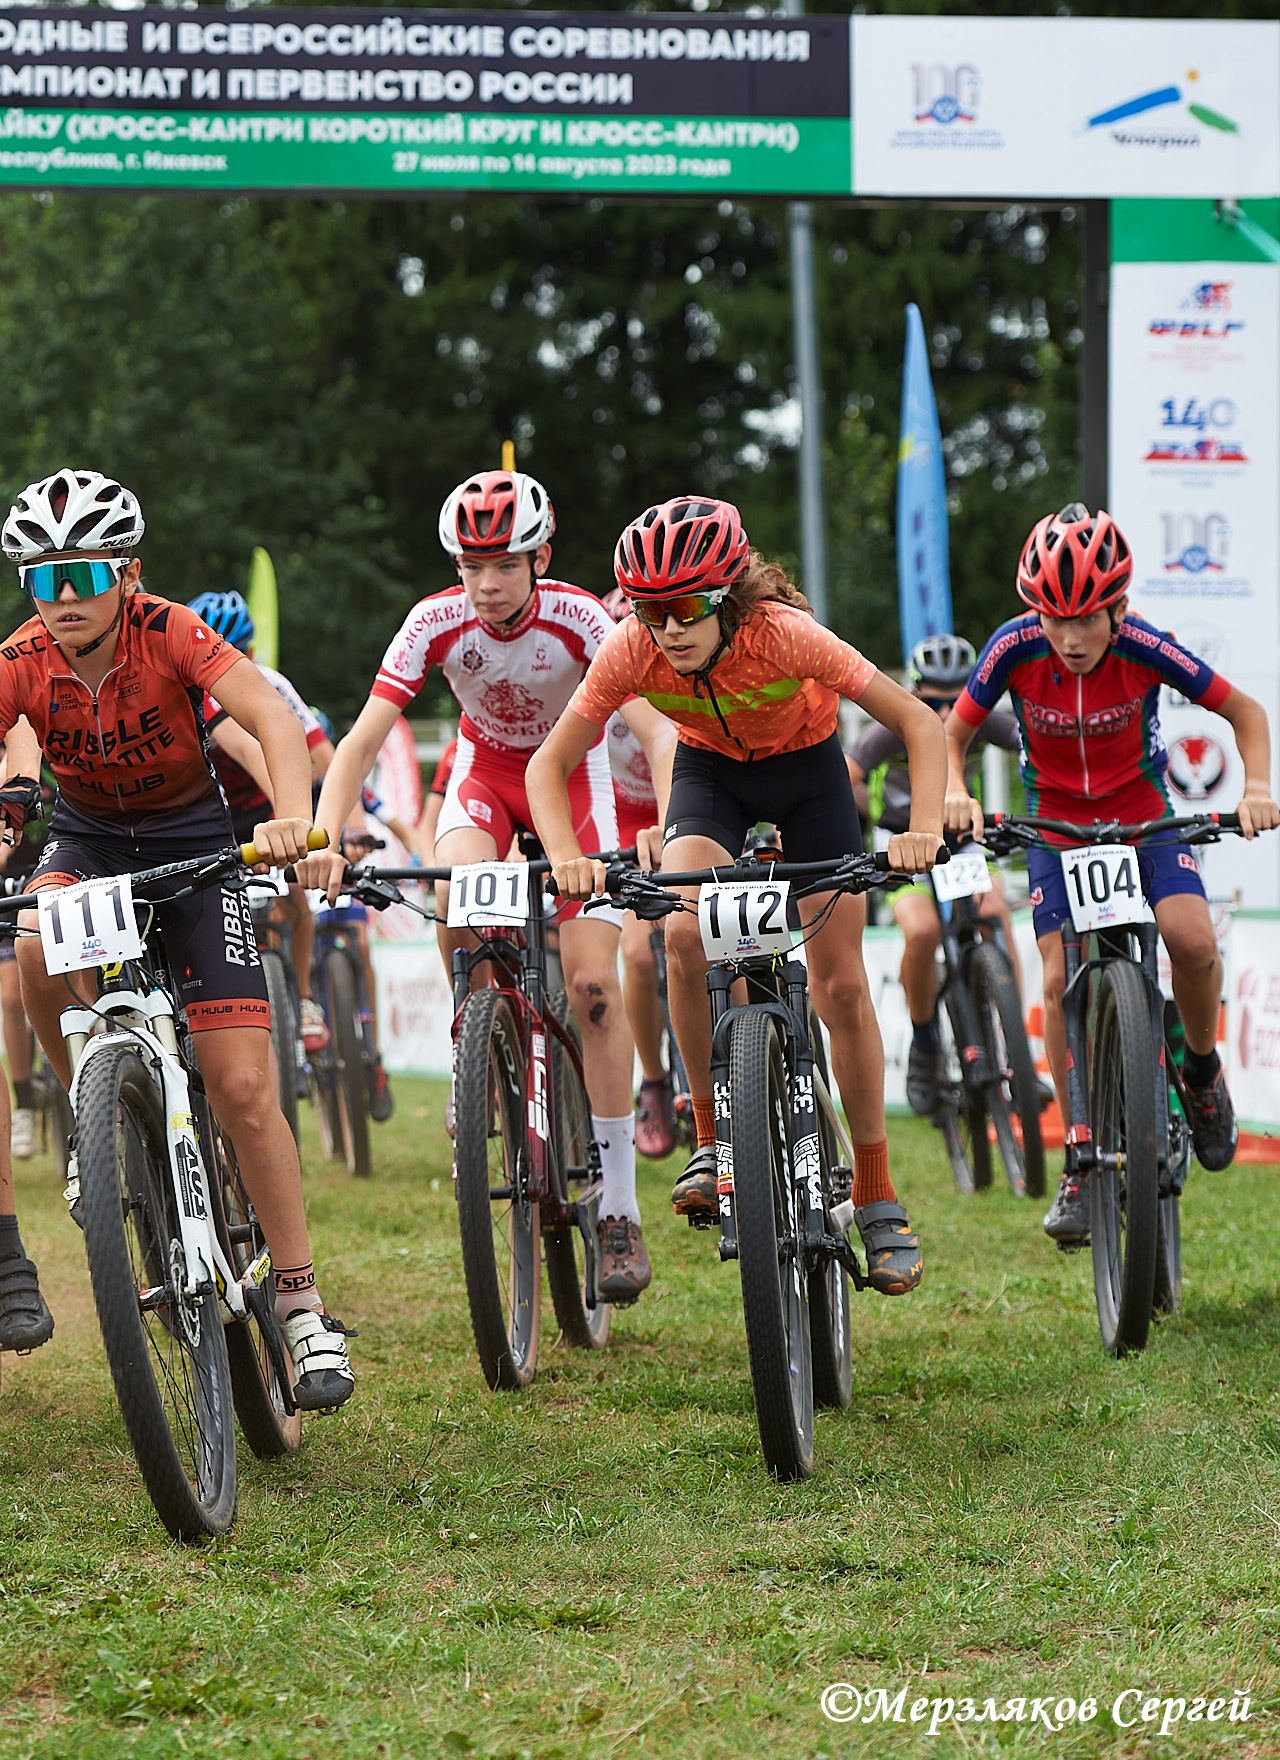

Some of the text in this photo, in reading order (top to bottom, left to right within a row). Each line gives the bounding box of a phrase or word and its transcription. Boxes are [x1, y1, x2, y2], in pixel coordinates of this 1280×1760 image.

[143, 21, 171, 53] И
[177, 17, 505, 57] ВСЕРОССИЙСКИЕ
[510, 27, 811, 61] СОРЕВНОВАНИЯ
[191, 68, 221, 99] И
[227, 68, 474, 101] ПЕРВЕНСТВО
[479, 72, 634, 104] РОССИИ
[65, 112, 305, 145] (КРОСС-КАНТРИ
[308, 113, 462, 144] КОРОТКИЙ
[468, 119, 538, 147] КРУГ
[540, 120, 563, 146] И
[567, 121, 800, 153] КРОСС-КАНТРИ)
[144, 151, 228, 171] Ижевск
[392, 153, 420, 173] 27
[483, 157, 510, 174] по
[512, 154, 536, 174] 14
[538, 158, 623, 179] августа
[625, 155, 677, 176] 2023
[99, 534, 137, 550] RUDY
[977, 632, 1020, 684] MOSCOW
[1159, 638, 1200, 677] REGION
[77, 772, 167, 799] HUUB
[455, 872, 520, 908] 101
[938, 862, 984, 886] 122
[1068, 858, 1137, 907] 104
[44, 885, 126, 945] 111
[221, 887, 246, 967] RIBB
[704, 890, 784, 939] 112
[201, 1005, 233, 1015] HUUB
[240, 1004, 267, 1014] HUUB
